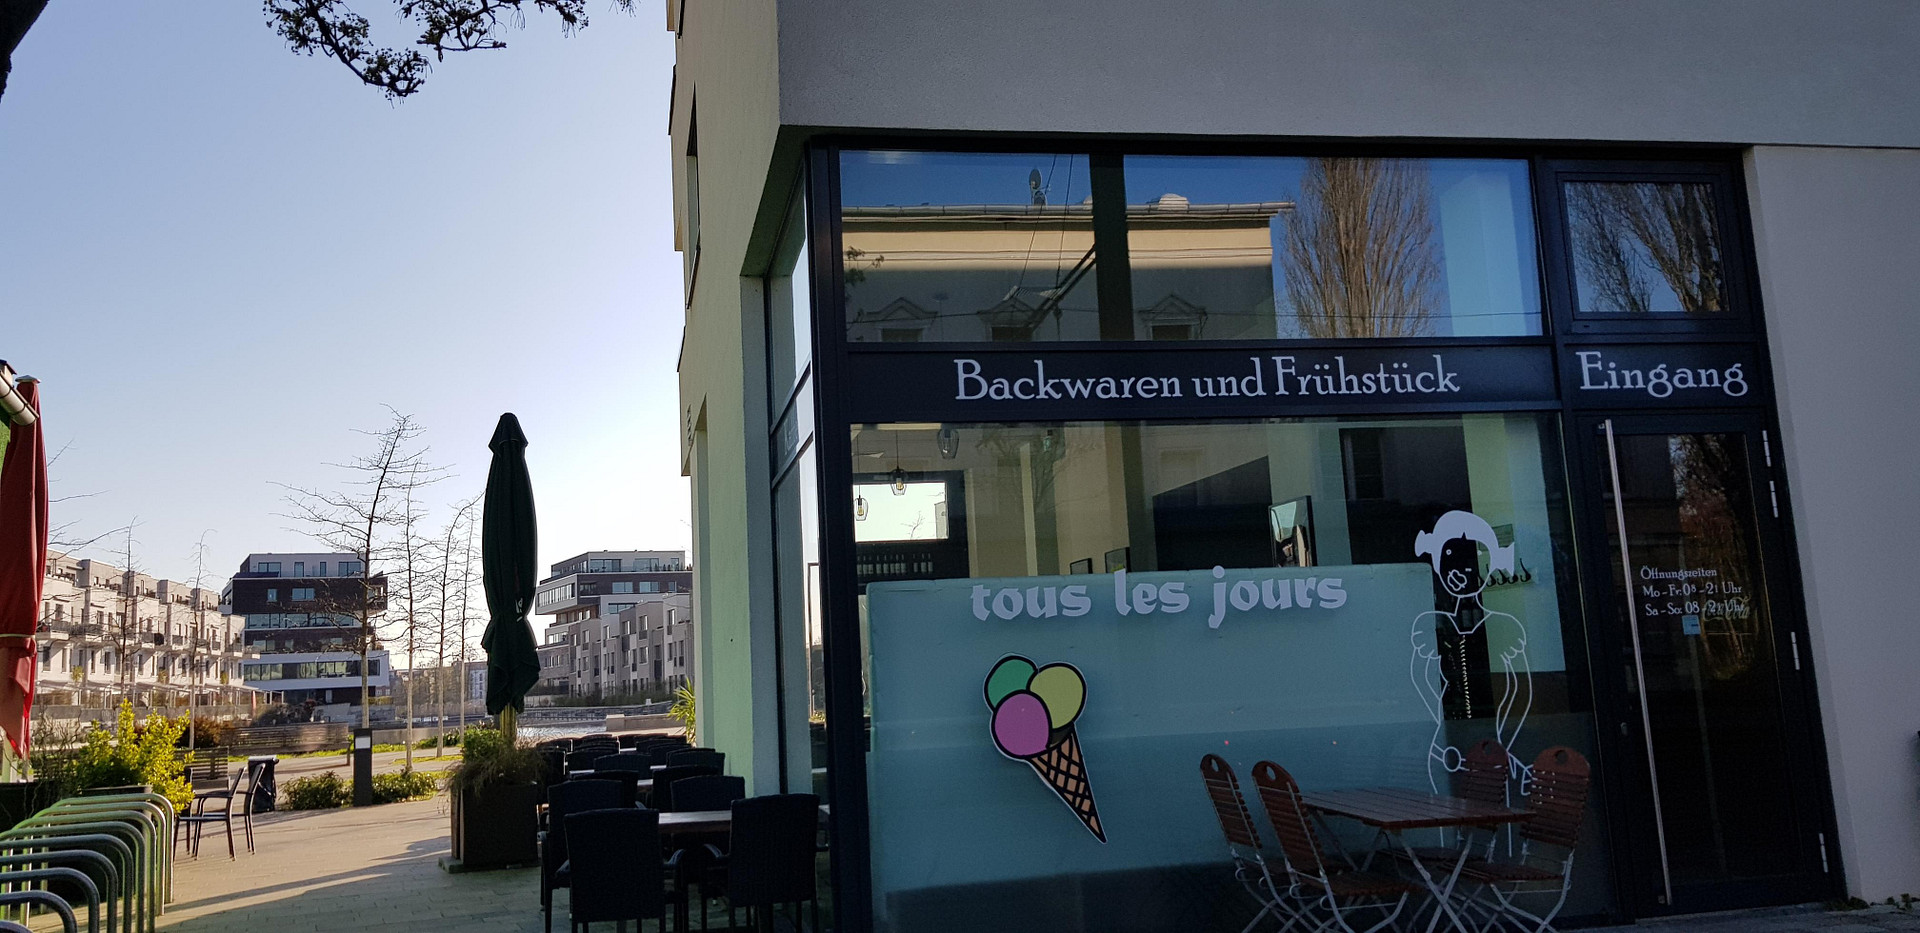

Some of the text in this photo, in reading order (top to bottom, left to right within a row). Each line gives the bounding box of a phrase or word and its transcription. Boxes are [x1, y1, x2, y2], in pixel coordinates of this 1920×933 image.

[954, 353, 1460, 400] Backwaren und Frühstück
[1576, 351, 1748, 398] Eingang
[1640, 565, 1717, 580] Öffnungszeiten
[970, 565, 1348, 629] tous les jours
[1642, 585, 1661, 598] Mo
[1721, 581, 1743, 594] Uhr
[1645, 603, 1659, 616] Sa
